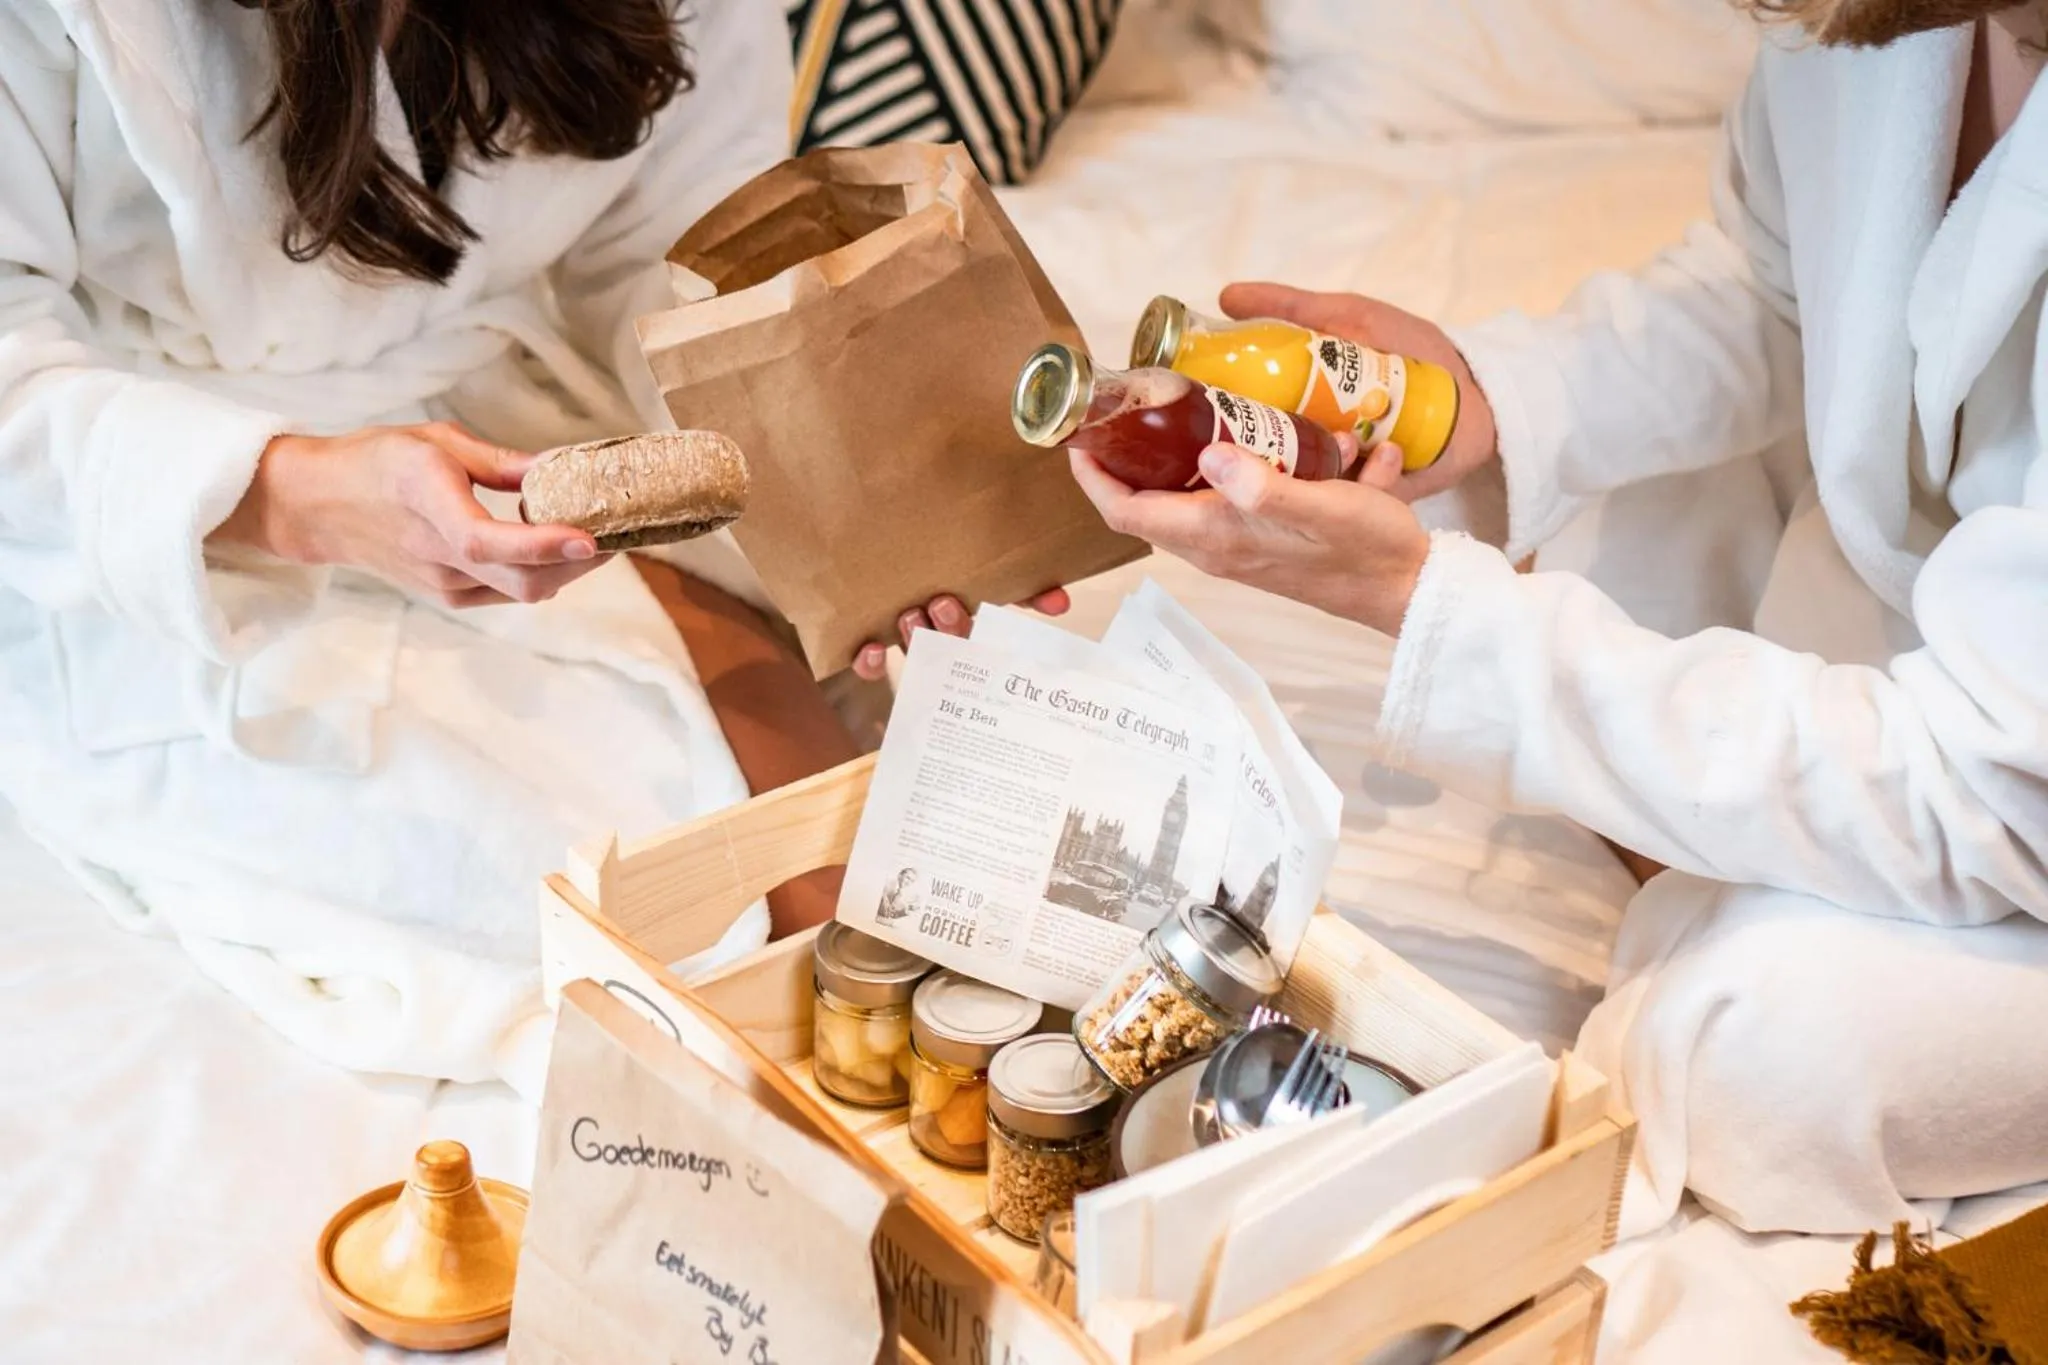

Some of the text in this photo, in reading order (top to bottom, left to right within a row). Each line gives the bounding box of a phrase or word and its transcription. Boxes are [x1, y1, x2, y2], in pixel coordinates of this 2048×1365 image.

[939, 698, 998, 727] Big Ben
[1004, 672, 1042, 702] The
[1049, 688, 1109, 721] Gastro
[1116, 707, 1189, 751] Telegraph
[931, 876, 984, 910] WAKE UP
[919, 912, 976, 948] COFFEE
[924, 905, 977, 926] MORNING
[571, 1116, 732, 1193] Goedemorgen
[655, 1239, 685, 1277] Eet
